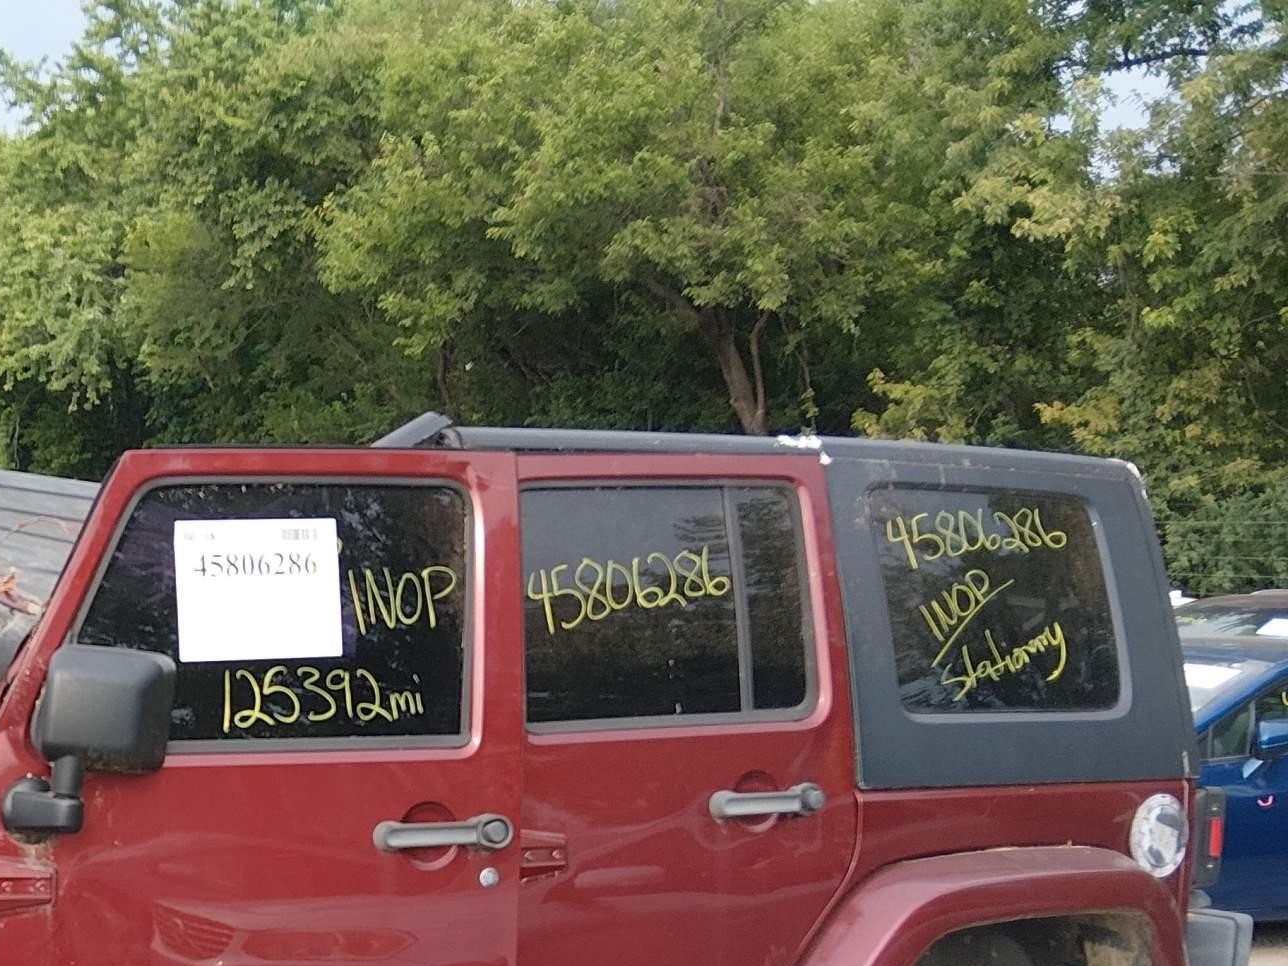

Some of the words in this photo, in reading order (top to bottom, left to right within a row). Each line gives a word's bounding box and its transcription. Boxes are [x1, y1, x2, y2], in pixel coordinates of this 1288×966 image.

[194, 552, 318, 577] 45806286
[886, 507, 1068, 570] 45806286
[527, 545, 731, 634] 45806286
